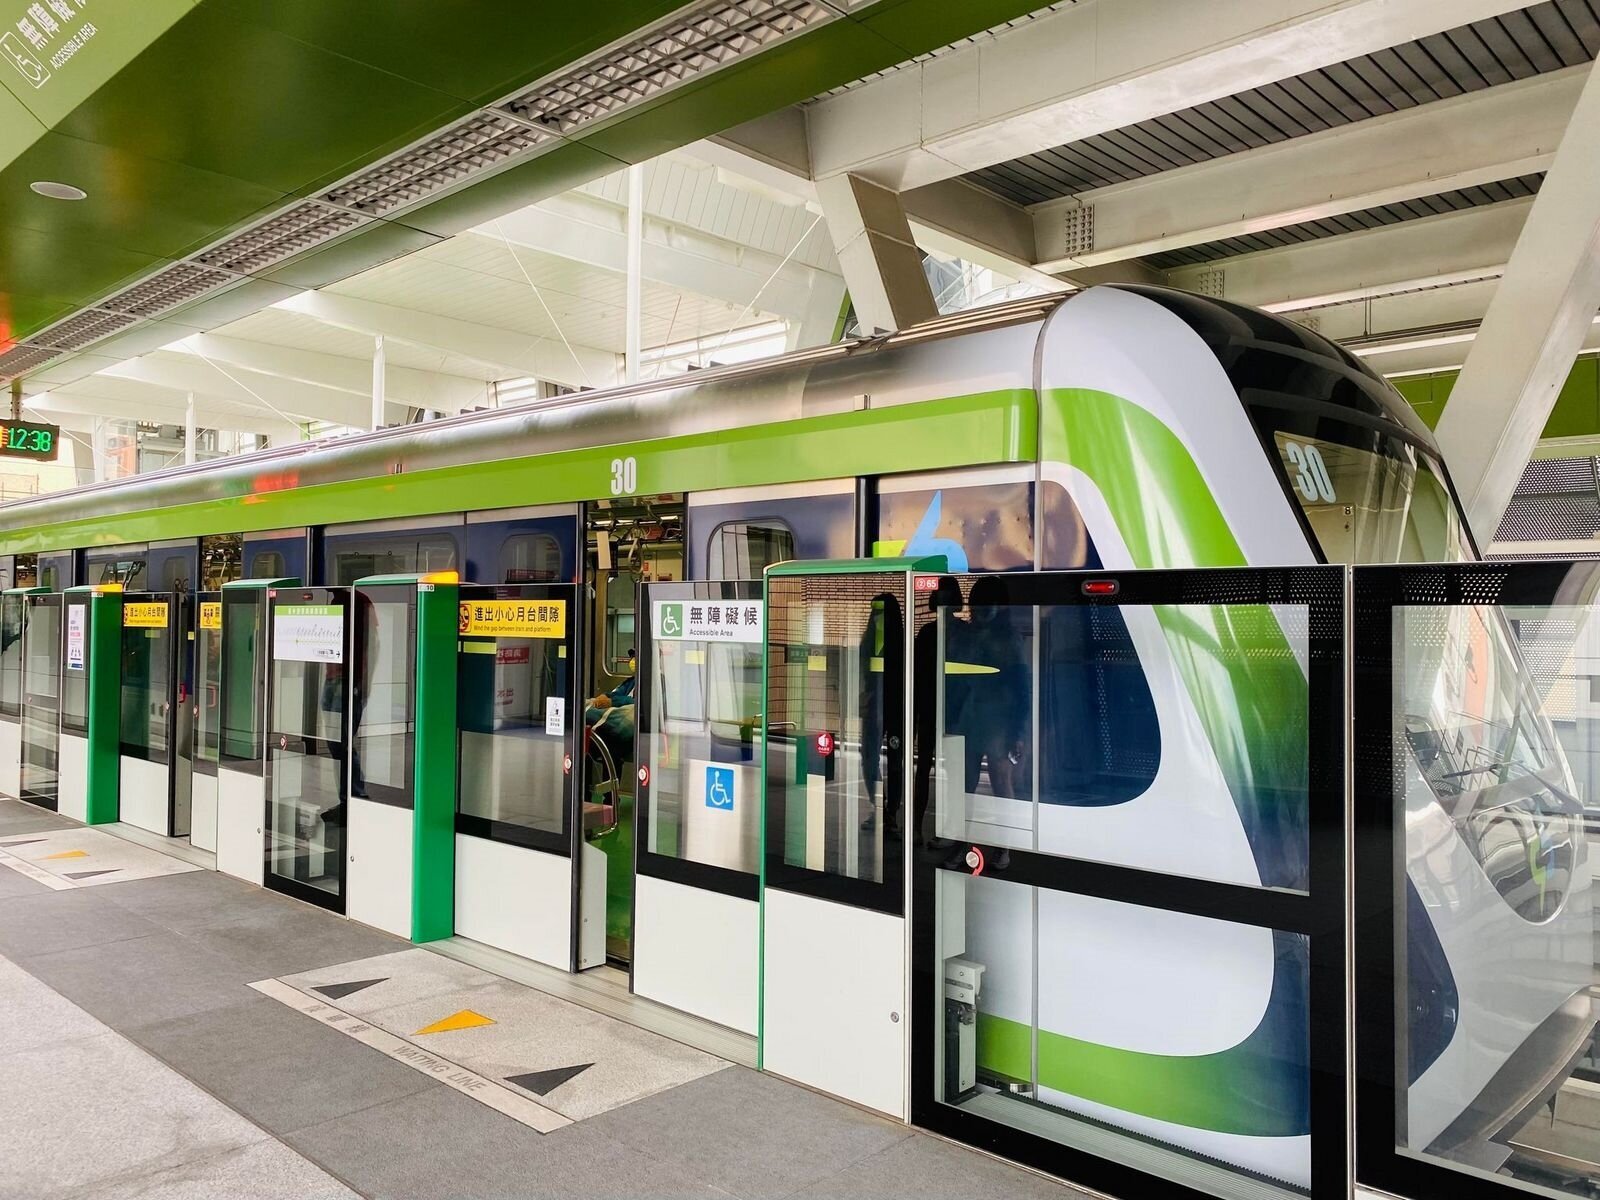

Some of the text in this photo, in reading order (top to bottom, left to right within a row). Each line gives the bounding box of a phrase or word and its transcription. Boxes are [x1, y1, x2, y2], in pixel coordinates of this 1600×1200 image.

[15, 0, 86, 51] 無障礙
[49, 22, 98, 70] ACCESSIBLE AREA
[7, 427, 51, 452] 12:38
[611, 456, 637, 495] 30
[1285, 442, 1337, 503] 30
[926, 579, 937, 588] 65
[474, 606, 559, 623] 進出小心月台間隙
[690, 606, 758, 626] 無障礙候
[689, 628, 734, 637] Accessible Area
[394, 1045, 487, 1092] WAITING LINE
